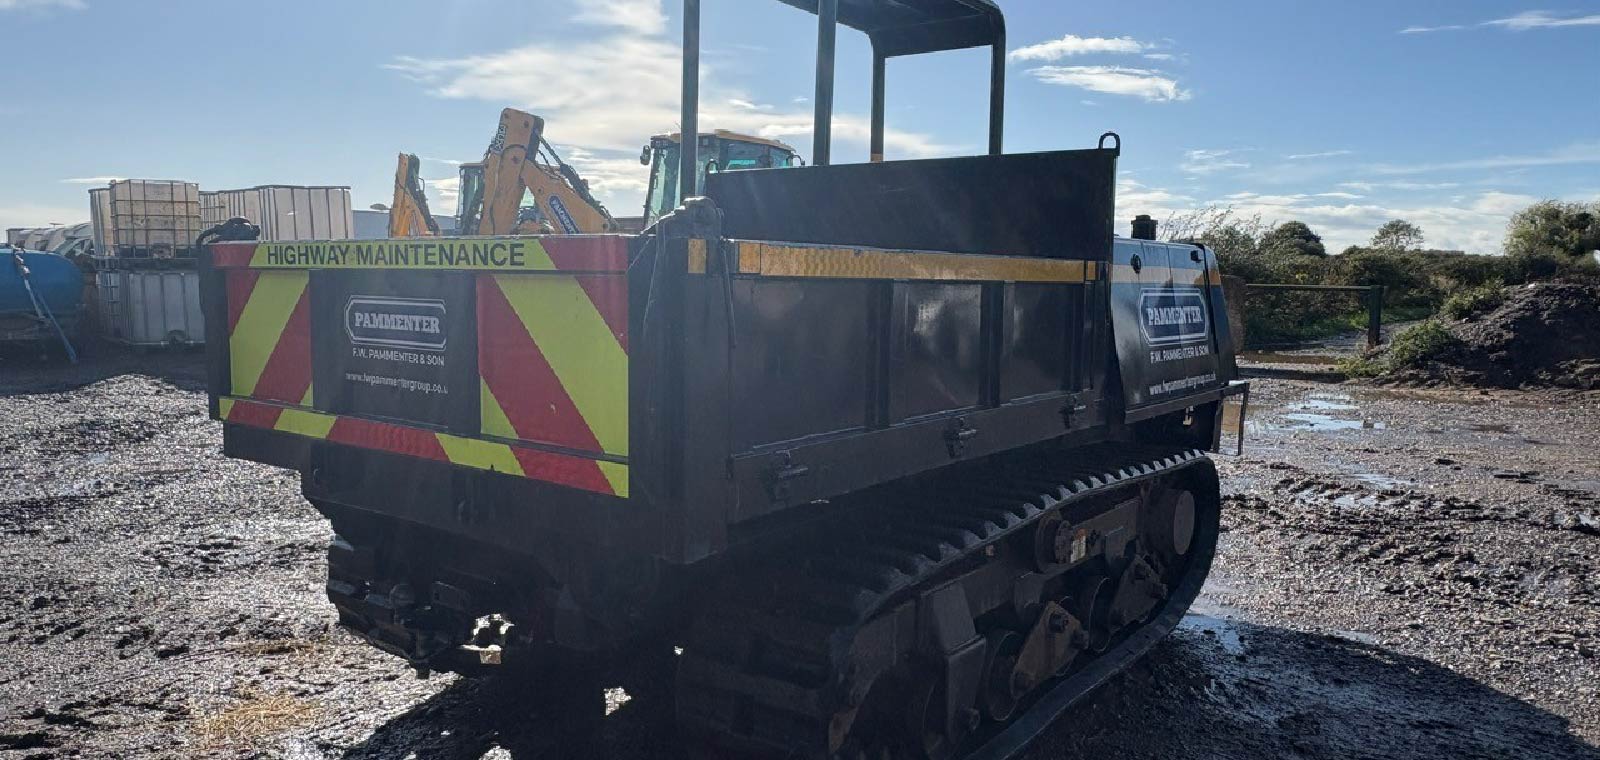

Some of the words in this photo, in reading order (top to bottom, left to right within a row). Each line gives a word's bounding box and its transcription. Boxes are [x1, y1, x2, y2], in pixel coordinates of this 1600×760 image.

[267, 245, 350, 264] HIGHWAY
[356, 243, 525, 266] MAINTENANCE
[354, 312, 441, 334] PAMMENTER
[1146, 306, 1203, 326] PAMMENTER
[352, 347, 369, 359] F.W.
[369, 348, 419, 363] PAMMENTER
[419, 354, 426, 365] &
[427, 355, 445, 366] SON
